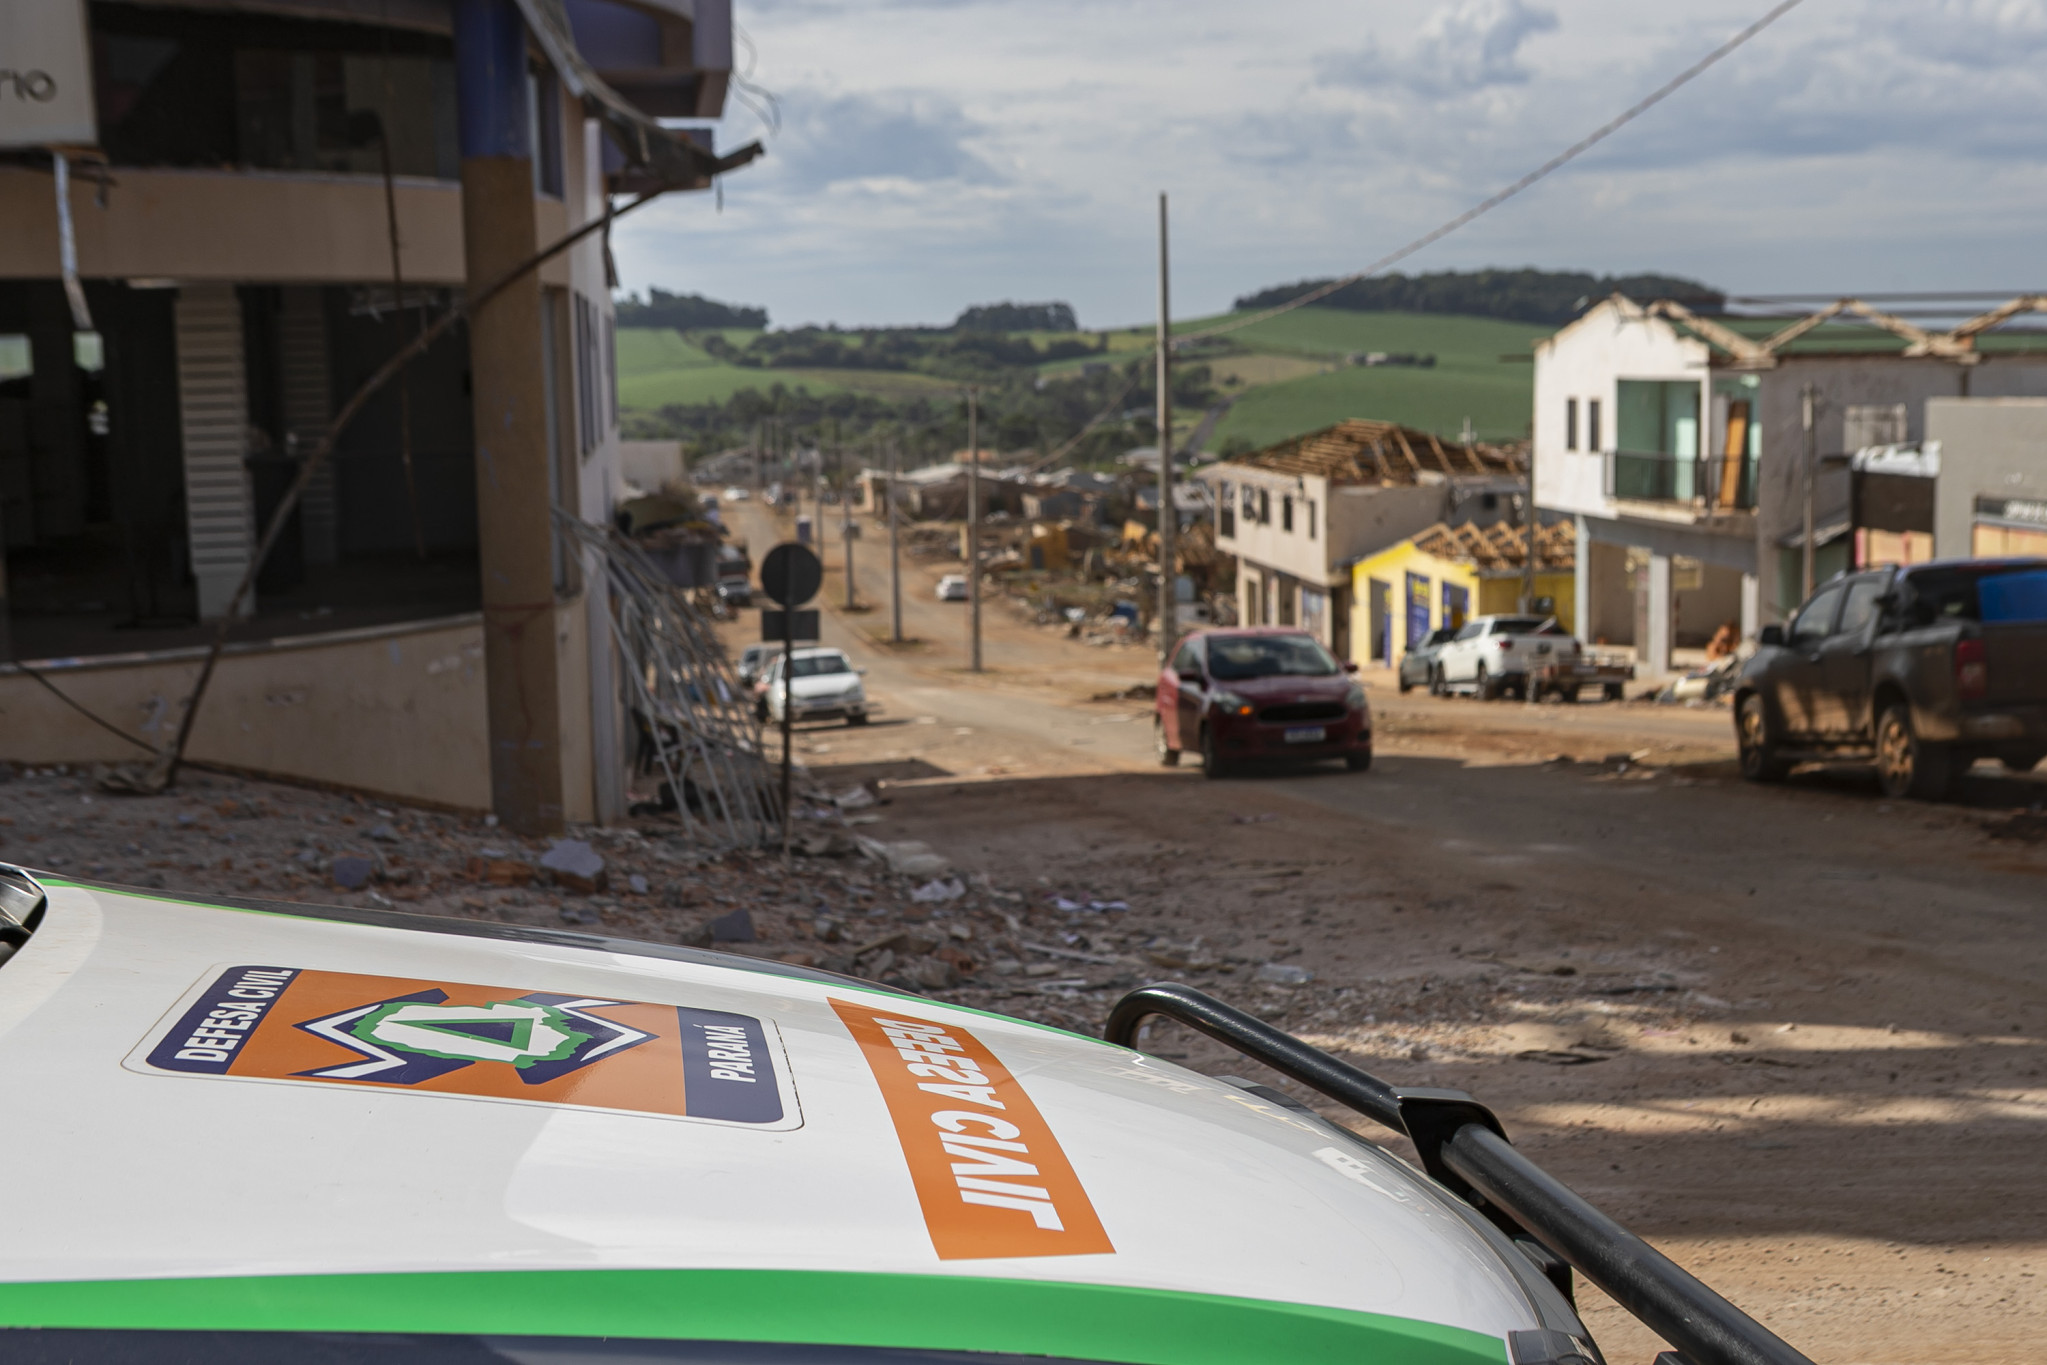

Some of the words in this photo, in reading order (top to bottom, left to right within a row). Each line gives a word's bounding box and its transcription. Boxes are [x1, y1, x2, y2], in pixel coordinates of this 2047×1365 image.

[174, 1002, 267, 1062] DEFESA
[227, 970, 293, 999] CIVIL
[693, 1023, 756, 1083] PARANÁ
